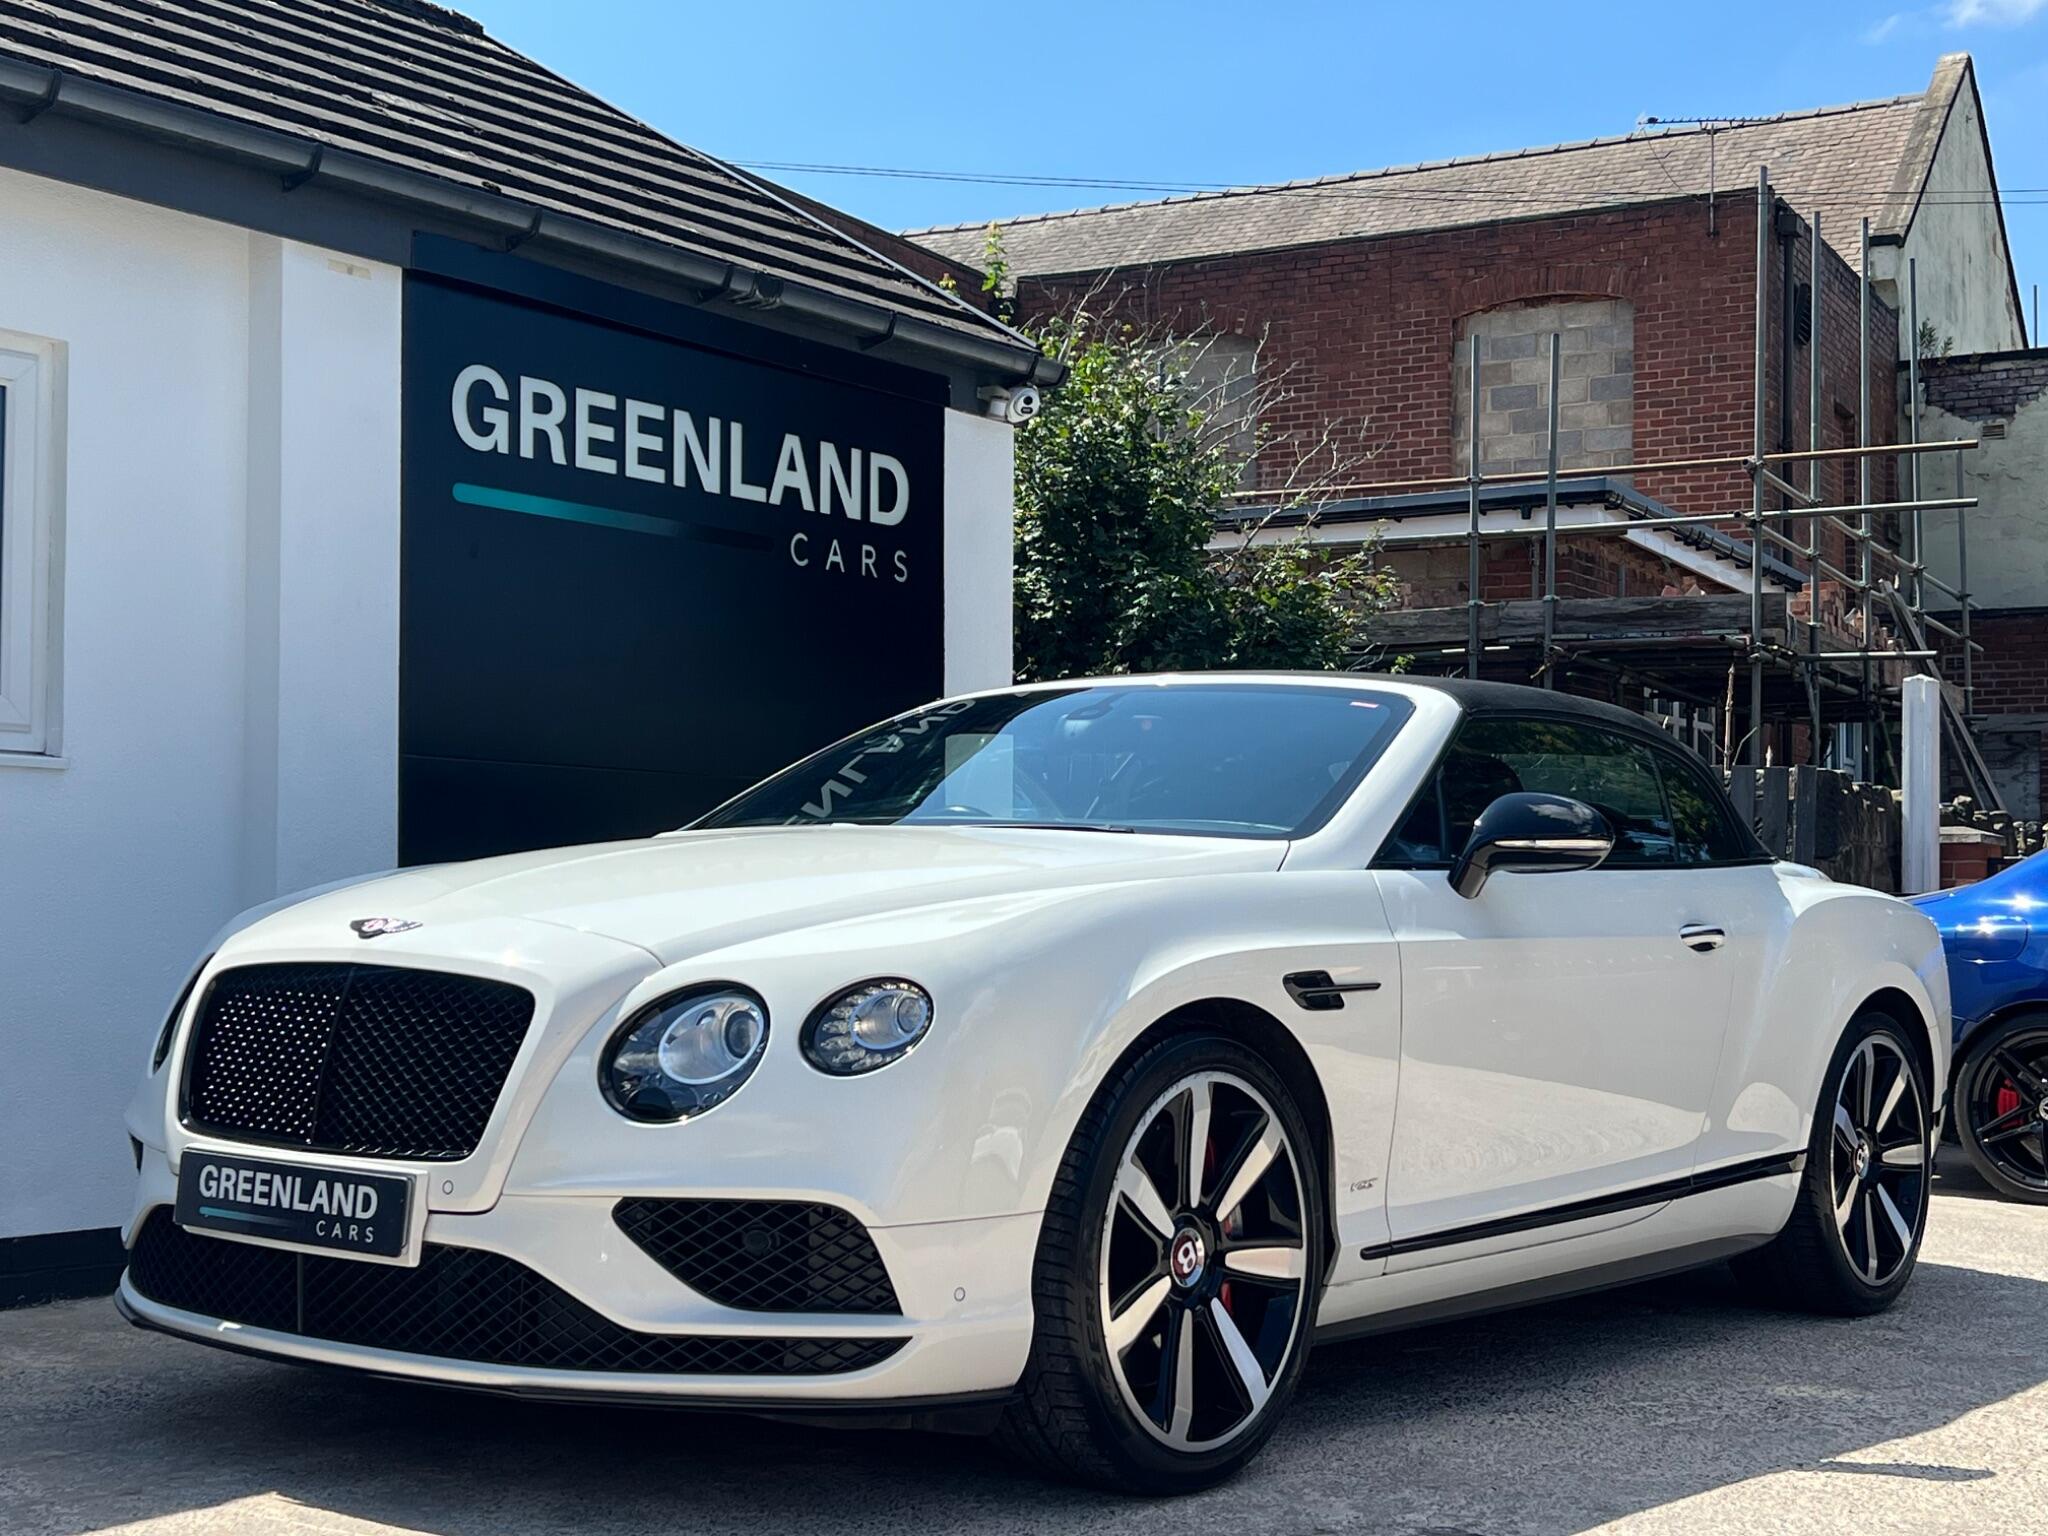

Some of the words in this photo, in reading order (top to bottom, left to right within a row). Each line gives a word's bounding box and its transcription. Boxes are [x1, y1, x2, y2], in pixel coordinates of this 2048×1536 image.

[452, 364, 909, 526] GREENLAND
[790, 532, 908, 583] CARS
[199, 1164, 378, 1220] GREENLAND
[315, 1220, 374, 1243] CARS
